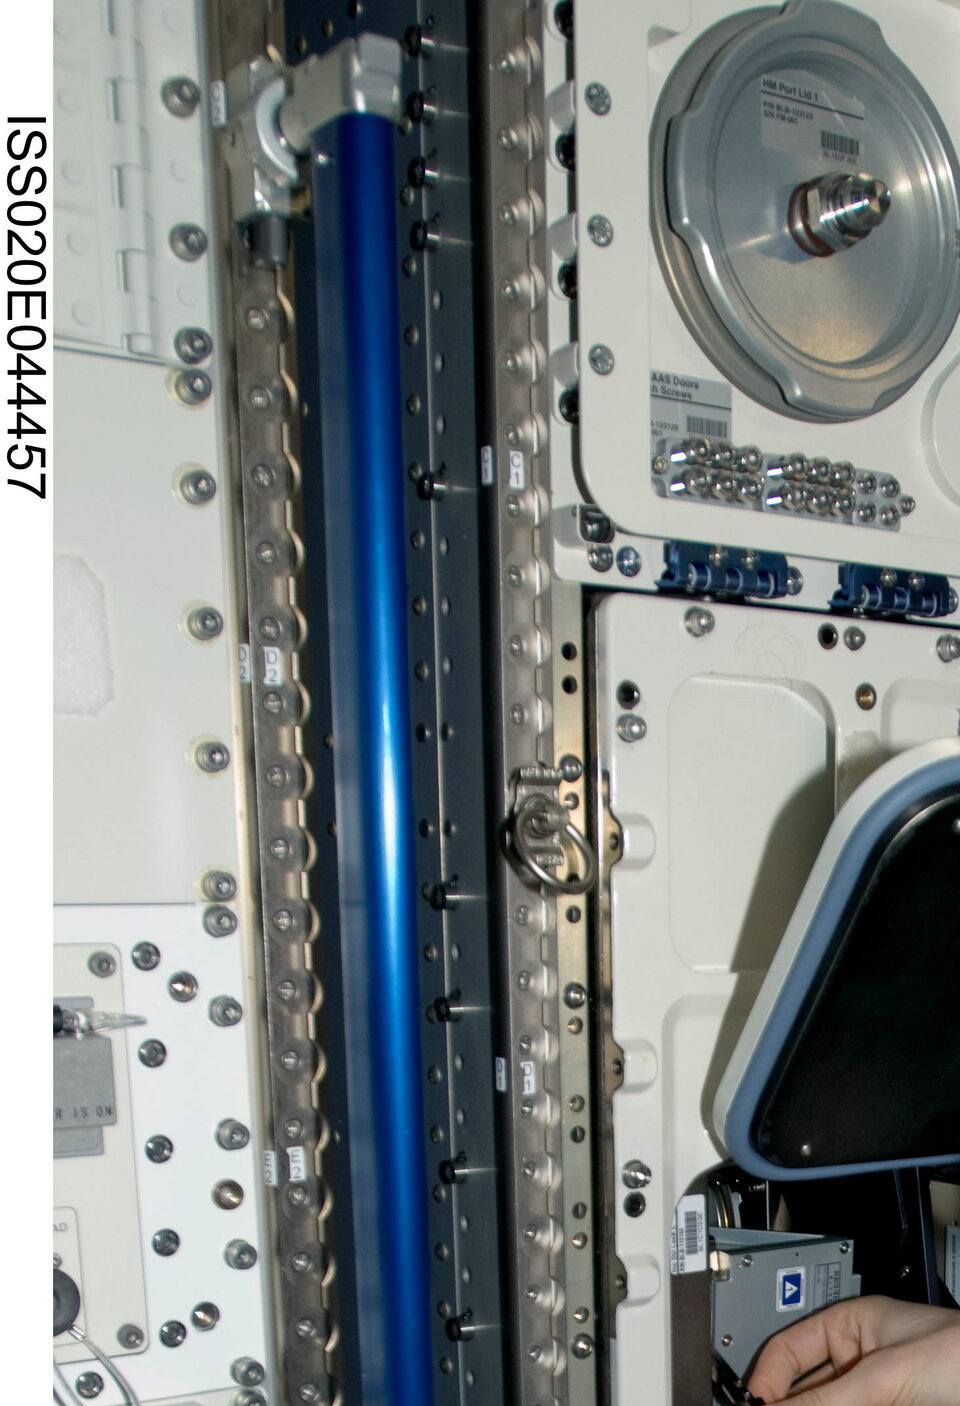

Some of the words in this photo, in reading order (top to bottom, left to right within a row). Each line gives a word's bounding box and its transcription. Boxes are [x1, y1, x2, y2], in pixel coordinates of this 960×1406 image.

[762, 78, 777, 90] HM
[778, 83, 797, 97] Port
[798, 87, 813, 100] Lid
[651, 372, 671, 385] AAS
[673, 375, 700, 389] Doors
[660, 385, 693, 400] Screws
[73, 1106, 88, 1119] IS
[95, 1104, 113, 1118] ON
